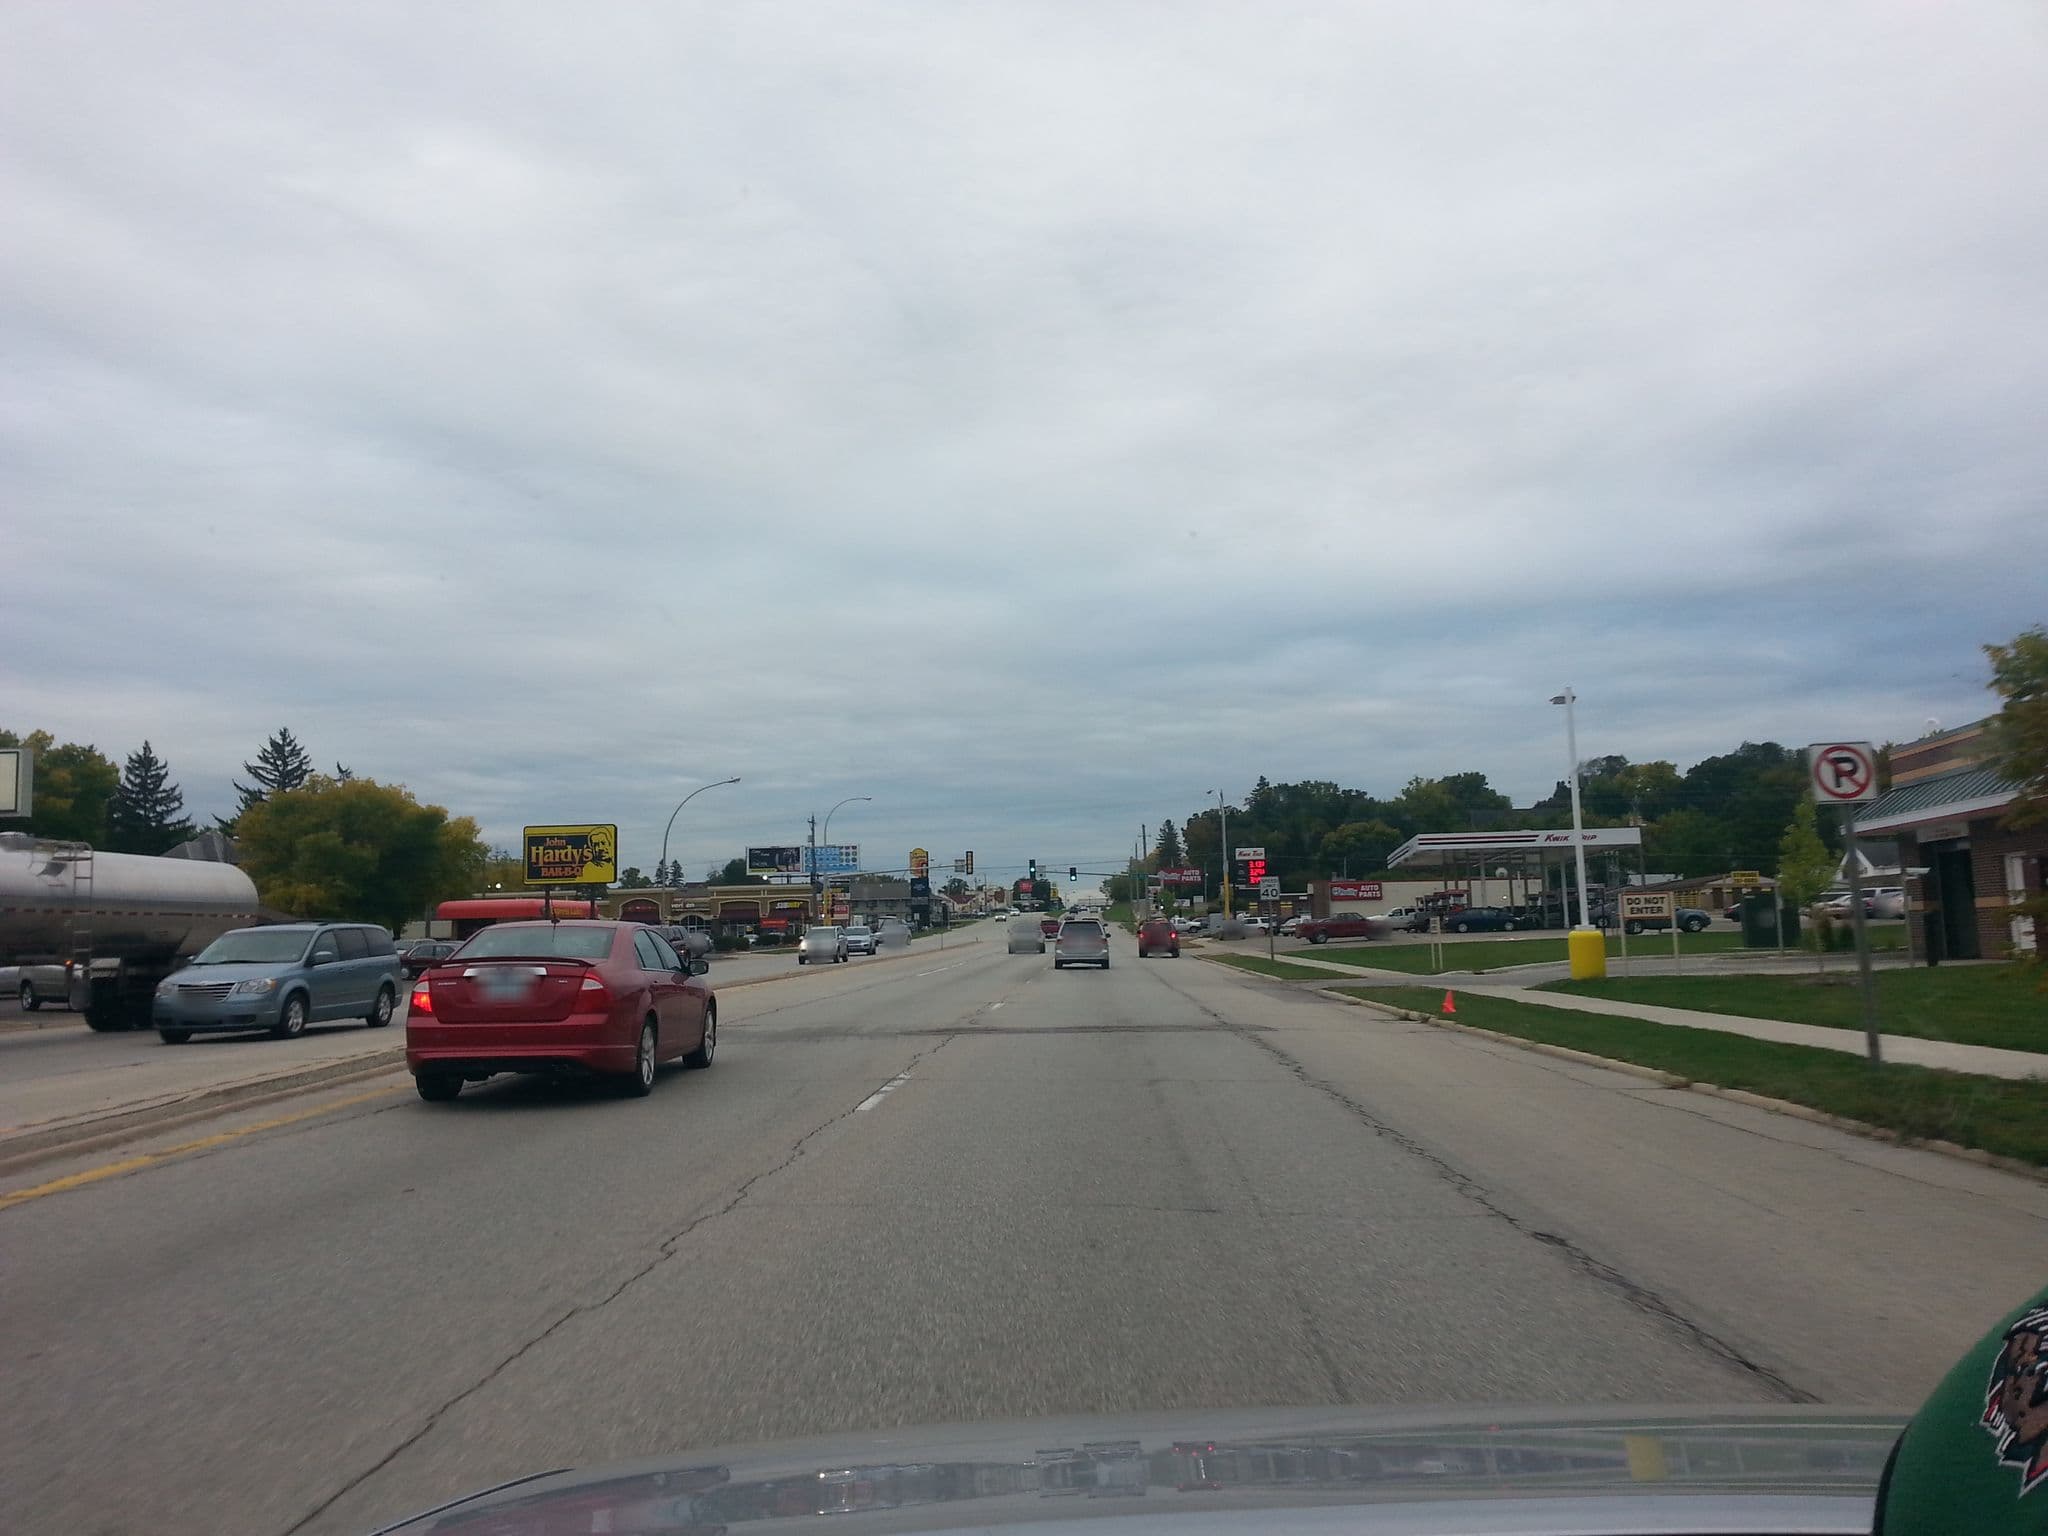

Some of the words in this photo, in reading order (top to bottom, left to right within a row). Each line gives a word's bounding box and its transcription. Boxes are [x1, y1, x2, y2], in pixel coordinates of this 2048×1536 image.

[544, 837, 566, 847] John
[531, 844, 593, 866] Hardy's
[1262, 888, 1278, 898] 40
[1626, 897, 1641, 905] DO
[1644, 896, 1666, 904] NOT
[1630, 906, 1664, 915] ENTER
